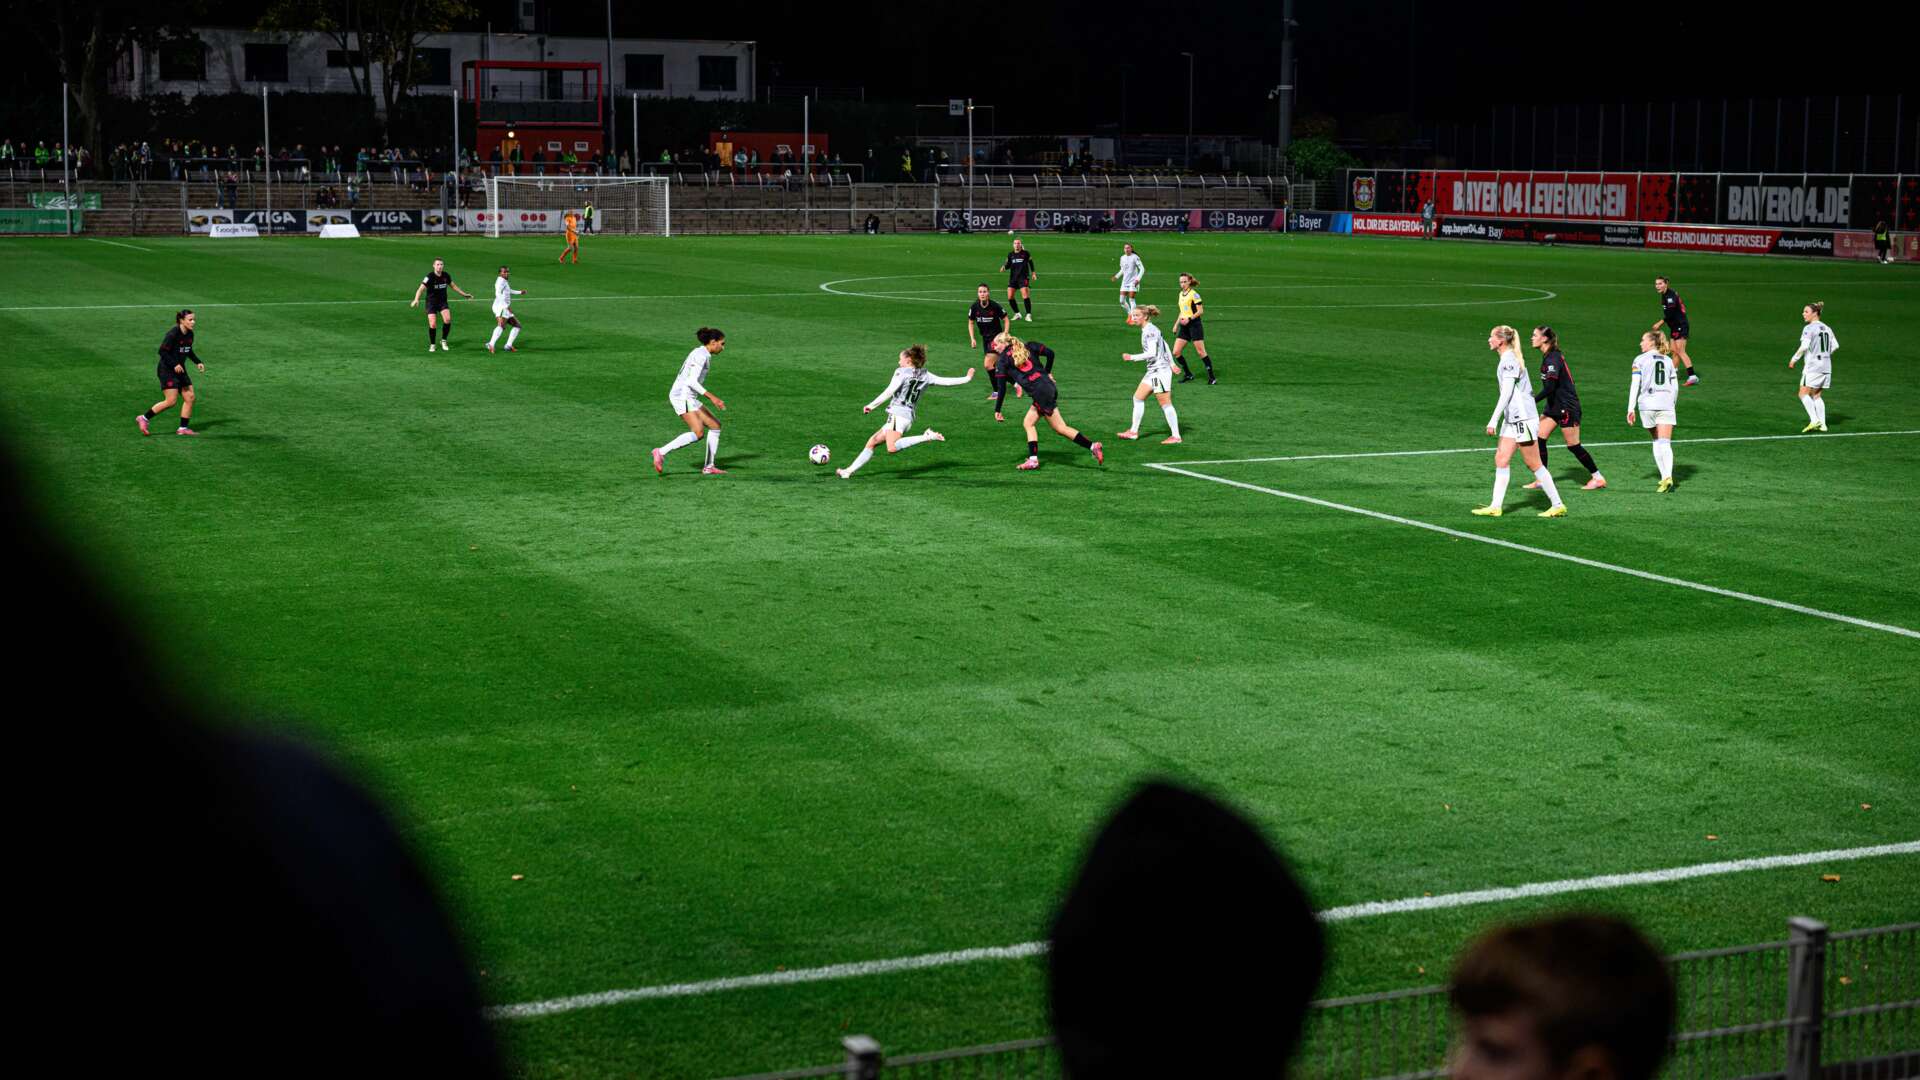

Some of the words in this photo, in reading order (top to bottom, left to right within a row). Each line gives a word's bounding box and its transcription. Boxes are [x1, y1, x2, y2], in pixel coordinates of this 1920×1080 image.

[1453, 181, 1500, 212] BAYER
[1503, 182, 1523, 213] 04
[1728, 185, 1849, 223] BAYER04.DE
[361, 211, 412, 223] STIGA
[1141, 213, 1179, 228] Bayer
[1227, 212, 1264, 228] Bayer
[1300, 215, 1322, 230] Bayer
[1353, 218, 1366, 230] HOL
[1367, 219, 1378, 231] DIR
[1378, 219, 1389, 231] DIE
[1389, 220, 1410, 232] BAYER
[1647, 231, 1672, 243] ALLES
[1673, 232, 1697, 244] RUND
[1697, 233, 1711, 245] UM
[1711, 234, 1724, 246] DIE
[1725, 234, 1772, 248] WERKSELF
[1778, 237, 1832, 250] shop.bayer04.de
[1818, 332, 1829, 352] 10
[1655, 360, 1665, 386] 6
[1513, 422, 1525, 434] 16
